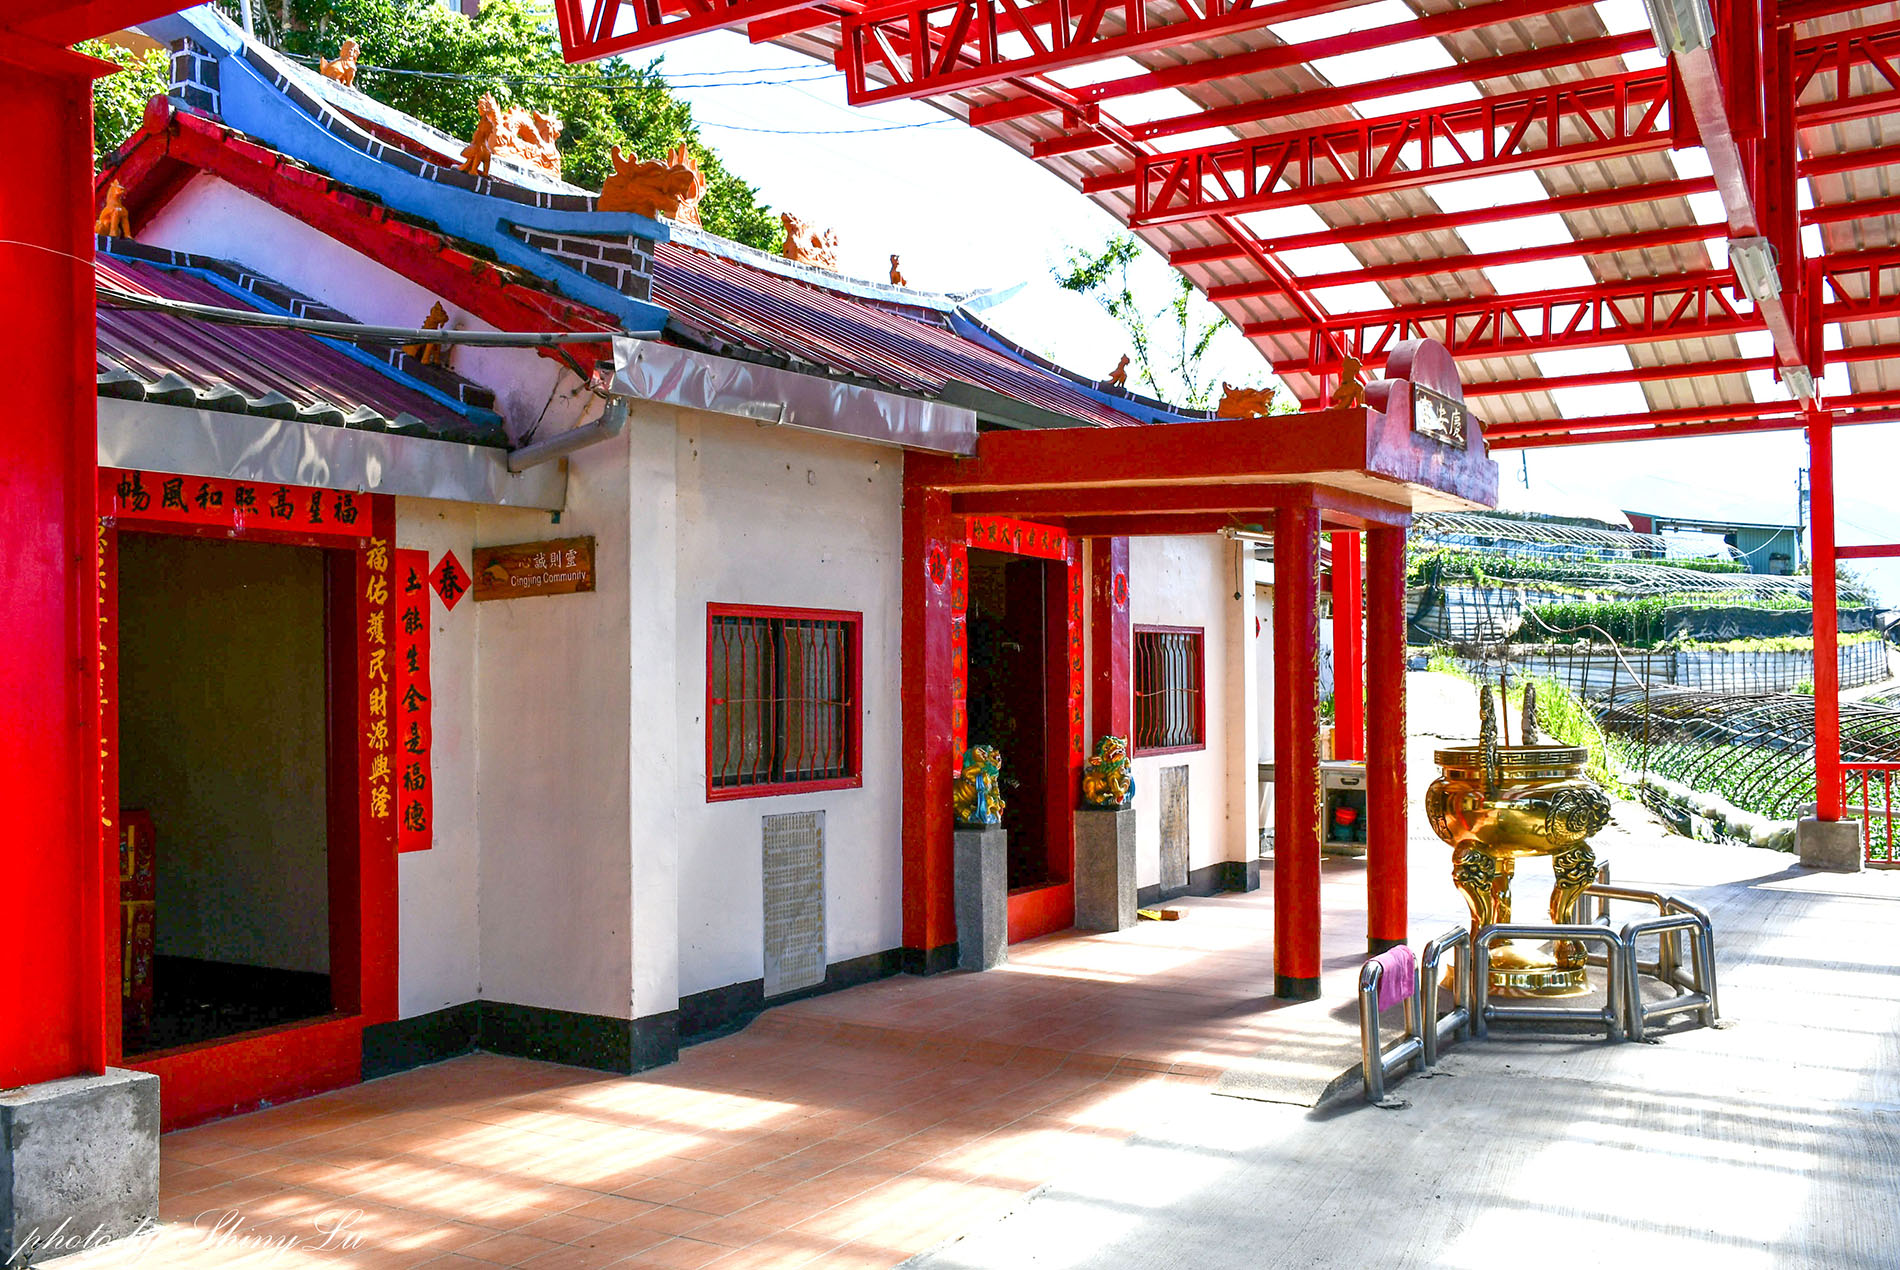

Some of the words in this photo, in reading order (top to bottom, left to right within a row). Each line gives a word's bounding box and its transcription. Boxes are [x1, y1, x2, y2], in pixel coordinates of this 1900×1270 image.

[116, 470, 360, 526] 福星高照和風暢
[510, 574, 542, 588] Cingjing
[543, 570, 587, 584] Community
[518, 548, 578, 569] 心誠則靈
[438, 559, 464, 600] 春
[365, 536, 391, 819] 福佑護民財源興隆
